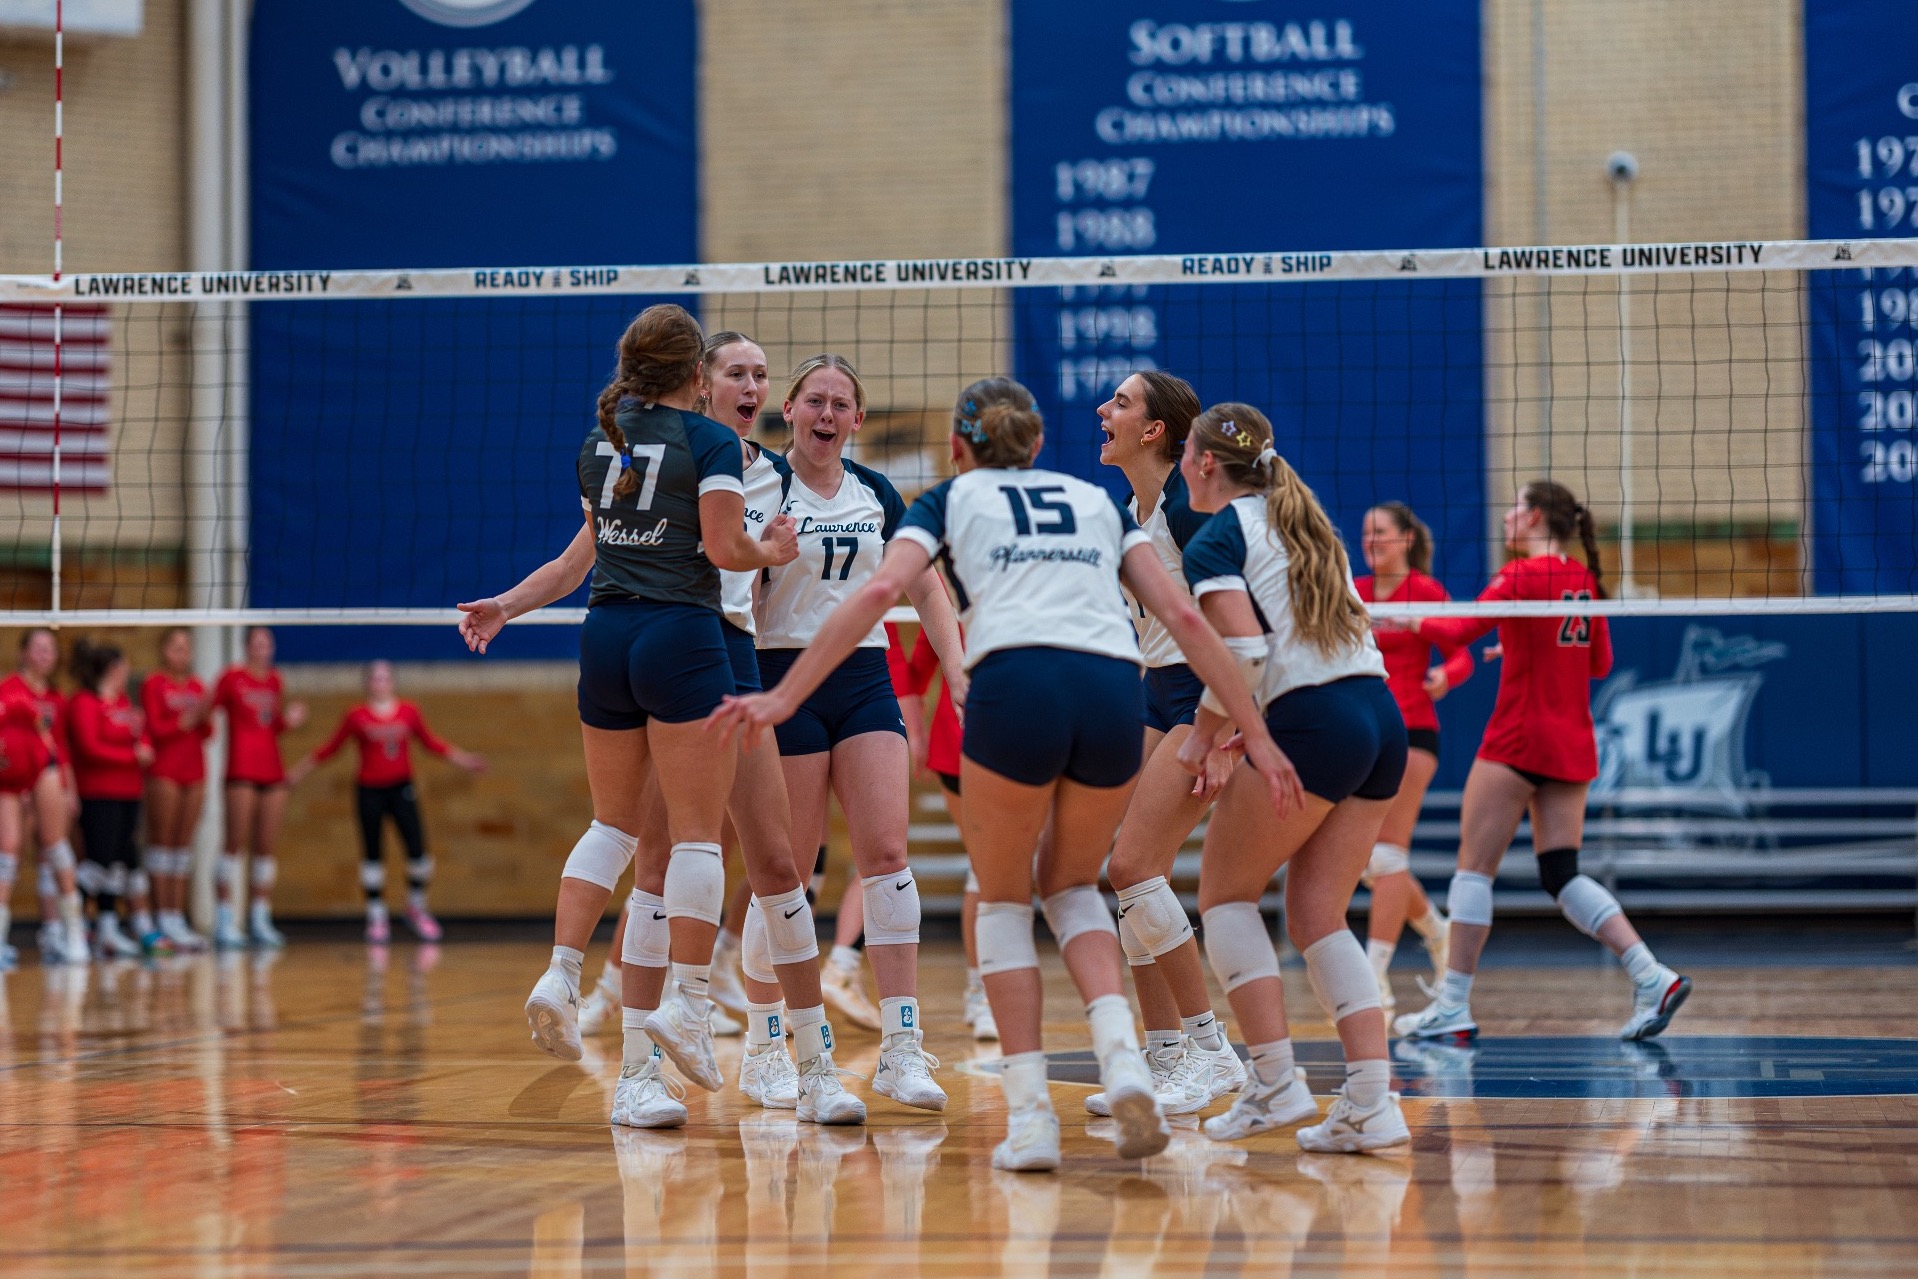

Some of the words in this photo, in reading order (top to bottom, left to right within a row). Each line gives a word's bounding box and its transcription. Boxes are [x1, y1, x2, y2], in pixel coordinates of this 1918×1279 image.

[1129, 19, 1362, 64] SOFTBALL
[334, 46, 613, 91] VOLLEYBALL
[1127, 68, 1362, 106] CONFERENCE
[360, 95, 582, 131] CONFERENCE
[1095, 104, 1395, 143] CHAMPIONSHIPS
[330, 129, 617, 168] CHAMPIONSHIPS
[1055, 157, 1154, 201] 1987
[1057, 206, 1156, 250] 1988
[764, 263, 887, 285] LAWRENCE
[897, 259, 1032, 282] UNIVERSITY
[1182, 256, 1254, 275] READY
[1281, 254, 1332, 273] SHIP
[1483, 249, 1611, 269] LAWRENCE
[1622, 243, 1763, 266] UNIVERSITY
[74, 275, 192, 295] LAWRENCE
[201, 270, 332, 294] UNIVERSITY
[474, 270, 544, 288] READY
[570, 269, 619, 286] SHIP
[595, 441, 667, 511] 77
[797, 516, 876, 536] Lawrence
[998, 484, 1077, 536] 15
[597, 516, 668, 546] Wessel
[821, 536, 859, 581] 17
[1646, 708, 1707, 783] LU
